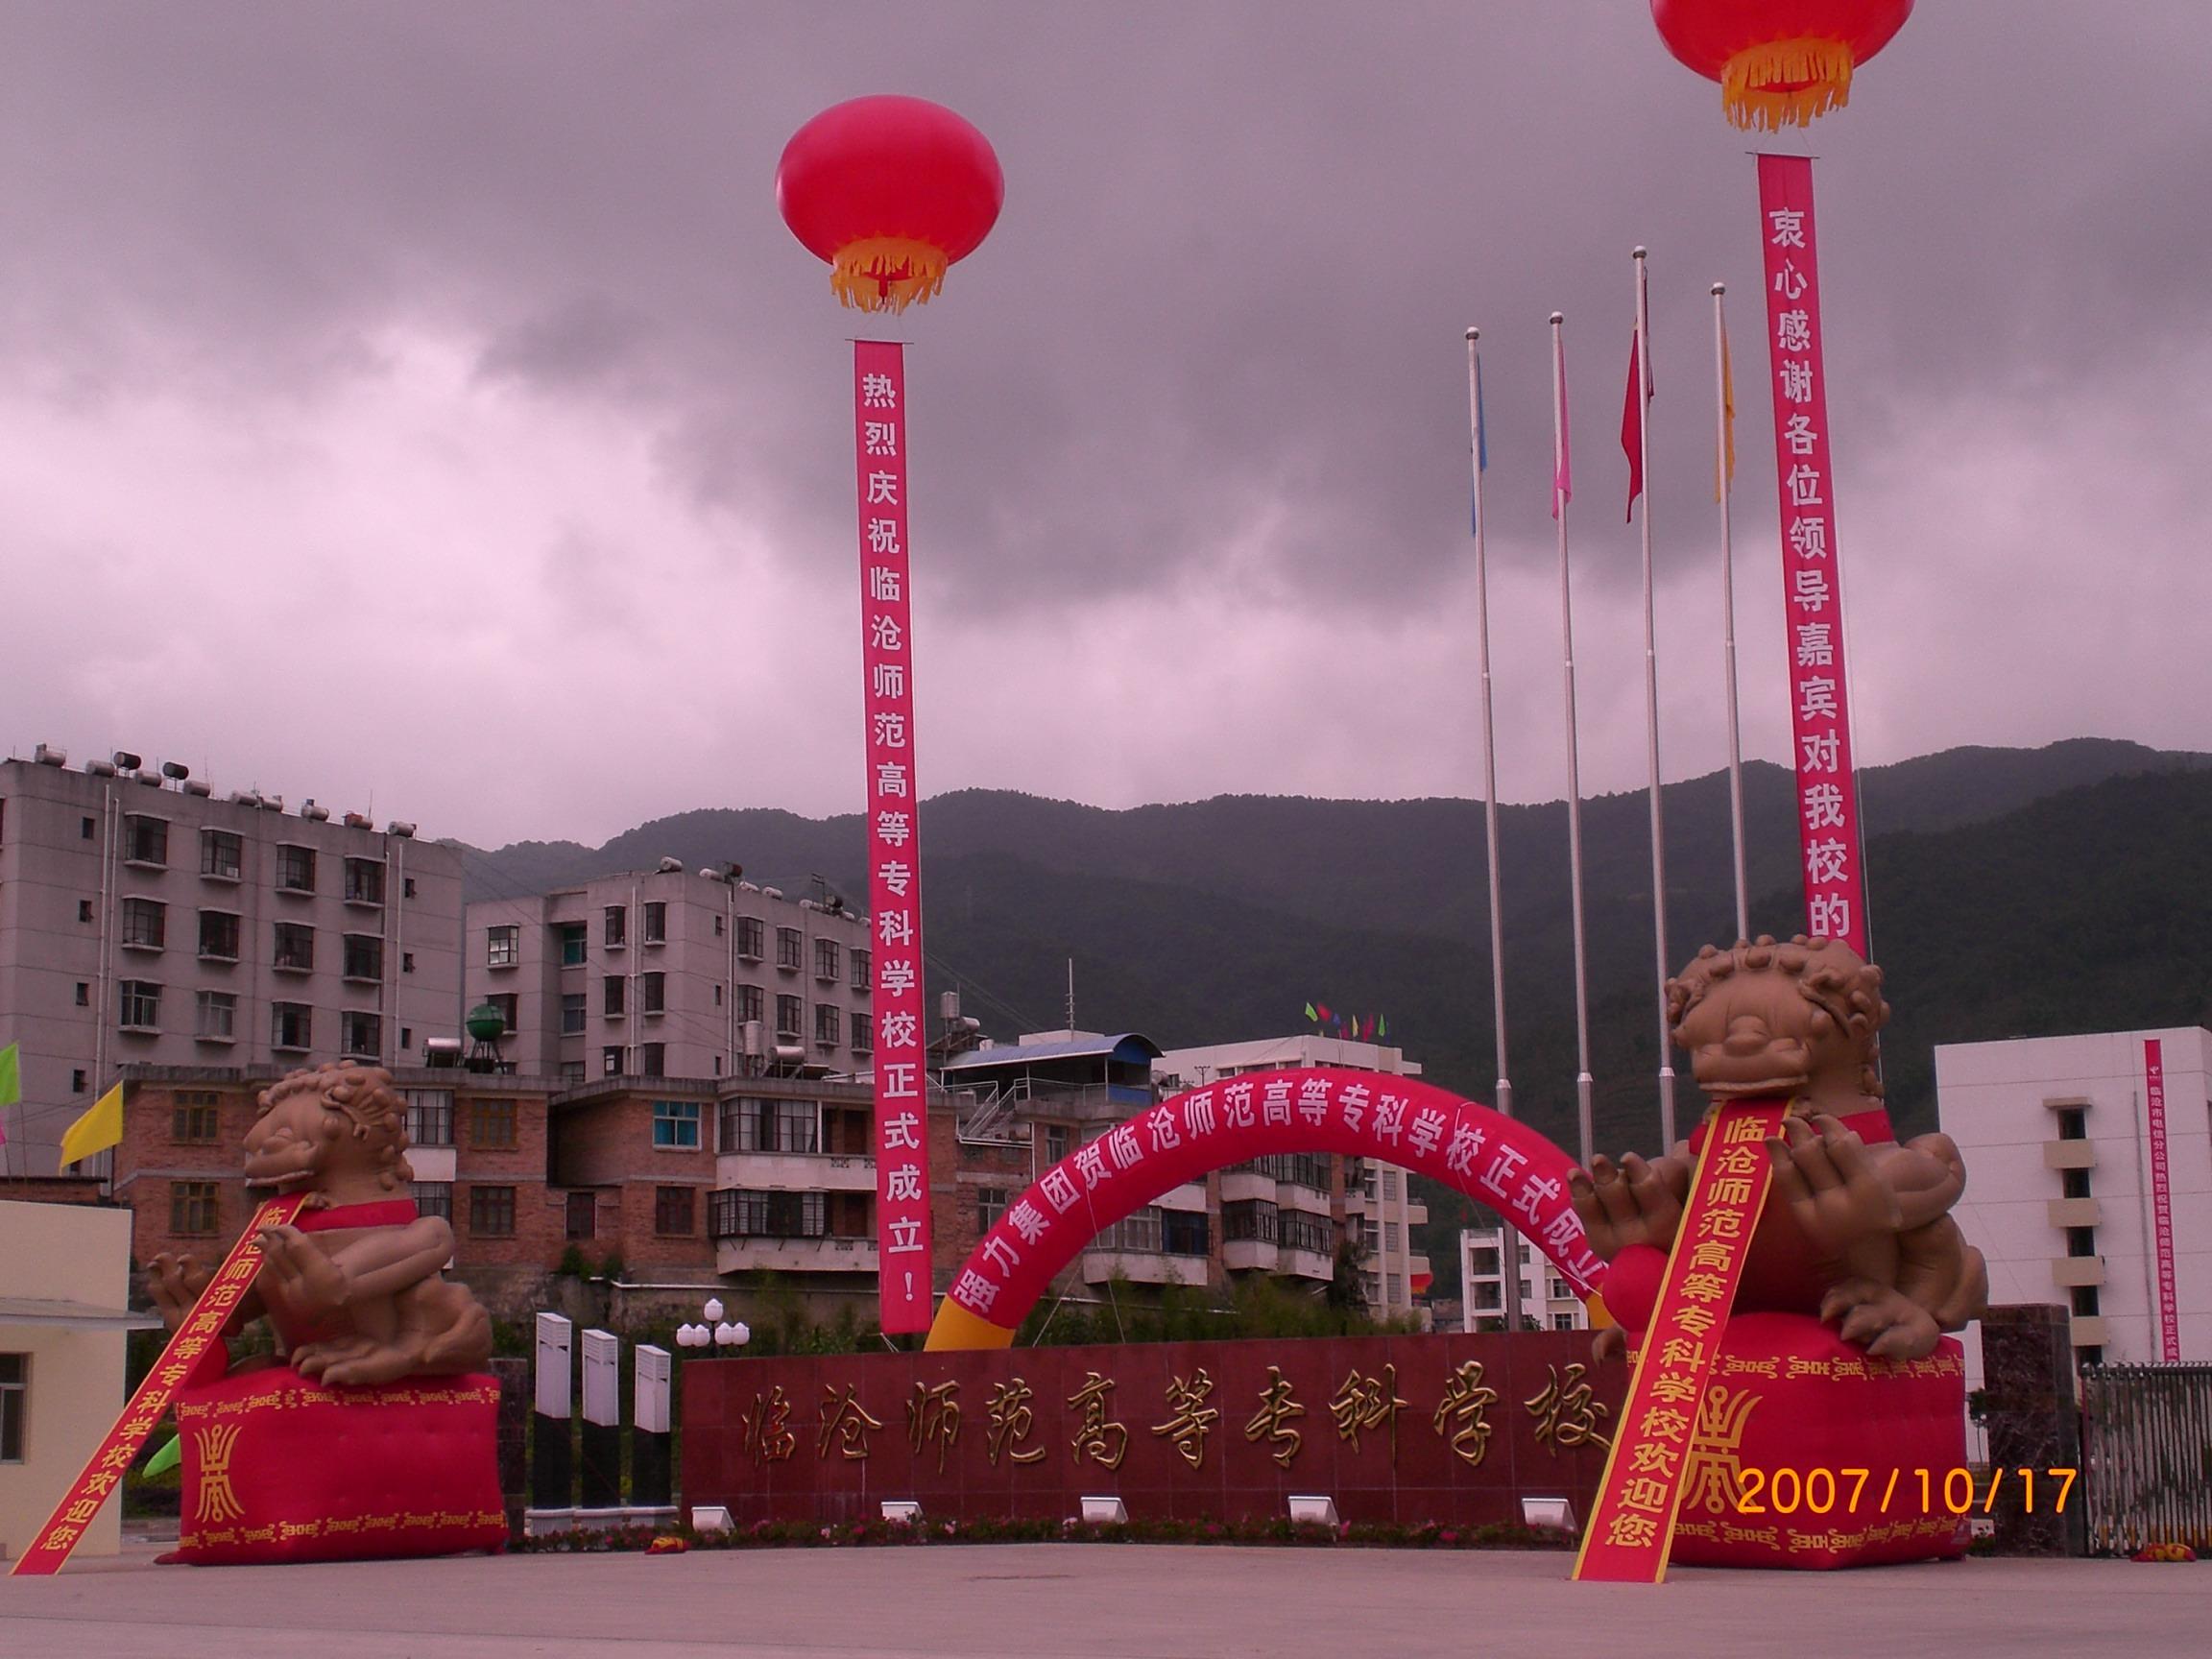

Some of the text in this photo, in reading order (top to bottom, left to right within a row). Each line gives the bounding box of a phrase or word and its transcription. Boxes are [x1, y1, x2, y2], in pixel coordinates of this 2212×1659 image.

[1768, 206, 1851, 938] 衷心感谢各位领导嘉宾对我校的
[863, 373, 924, 1302] 热烈庆祝临沧师范高等专科学校正式成立！
[953, 1077, 1609, 1313] 强力集团贺临沧师范高等专科学校正式成立
[1605, 1117, 1768, 1548] 临沧师范高等专科学校欢迎您
[2149, 1086, 2178, 1362] 临沧市电信分公司热烈祝贺临沧师范高等专科学校正式成
[741, 1360, 1612, 1475] 临沧师范高等专科学校
